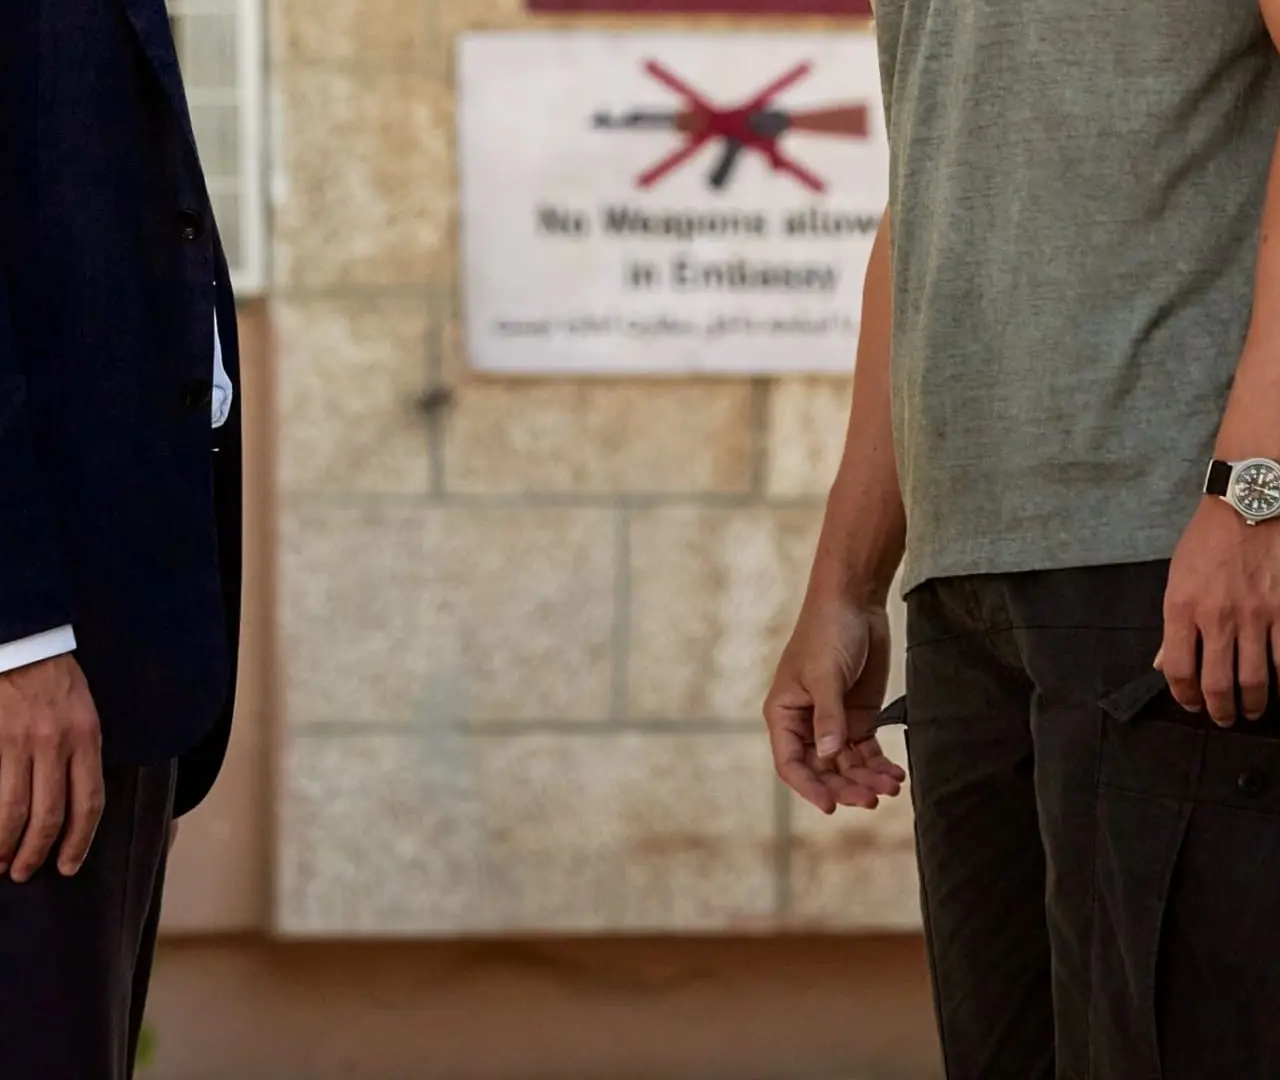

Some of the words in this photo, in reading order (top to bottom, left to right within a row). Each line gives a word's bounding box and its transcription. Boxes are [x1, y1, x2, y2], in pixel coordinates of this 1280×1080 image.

[538, 204, 586, 236] No
[605, 204, 766, 242] Weapons
[629, 261, 656, 290] in
[671, 259, 836, 294] Embassy
